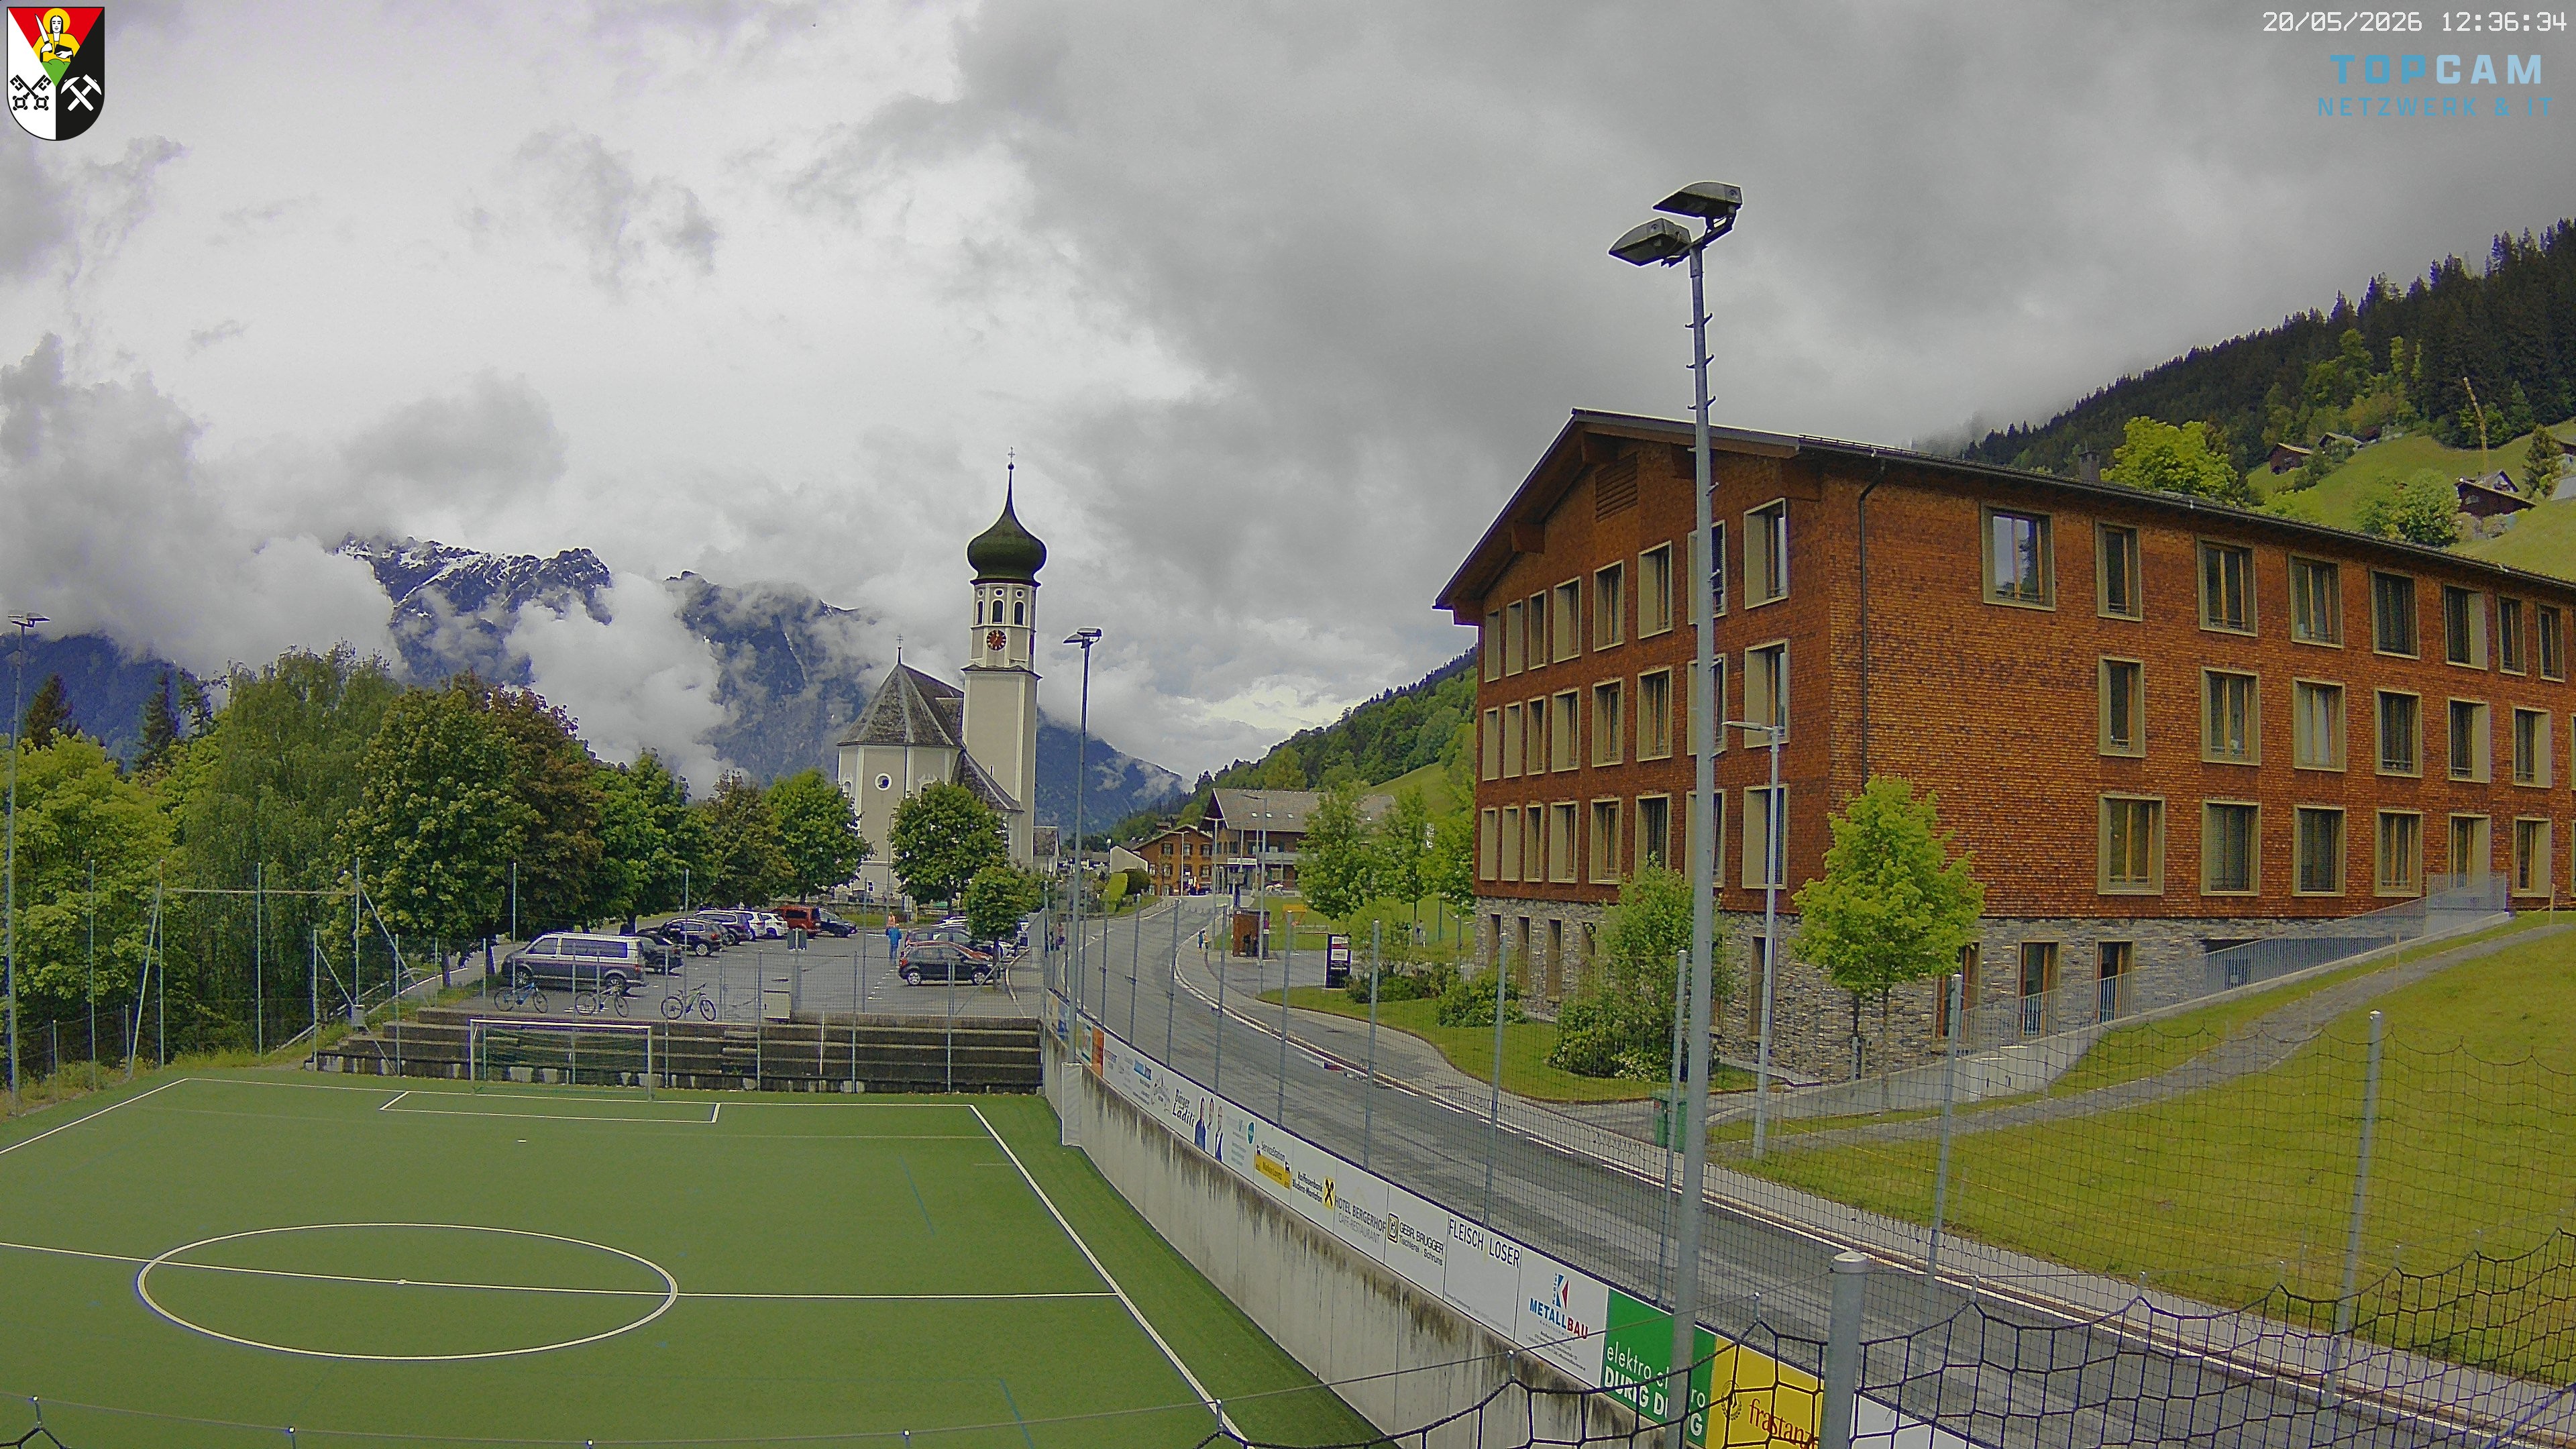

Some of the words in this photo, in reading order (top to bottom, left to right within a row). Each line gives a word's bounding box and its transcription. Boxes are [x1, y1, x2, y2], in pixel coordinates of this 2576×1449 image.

[1335, 1195, 1351, 1216] HOTEL
[1352, 1205, 1387, 1234] BERGERHOF
[1424, 1248, 1443, 1267] Schruns
[1448, 1218, 1485, 1251] FLEISCH
[1489, 1238, 1521, 1269] LOSER
[1529, 1297, 1589, 1340] METALLBAU
[1607, 1341, 1652, 1380] elektro
[1656, 1366, 1706, 1408] elro
